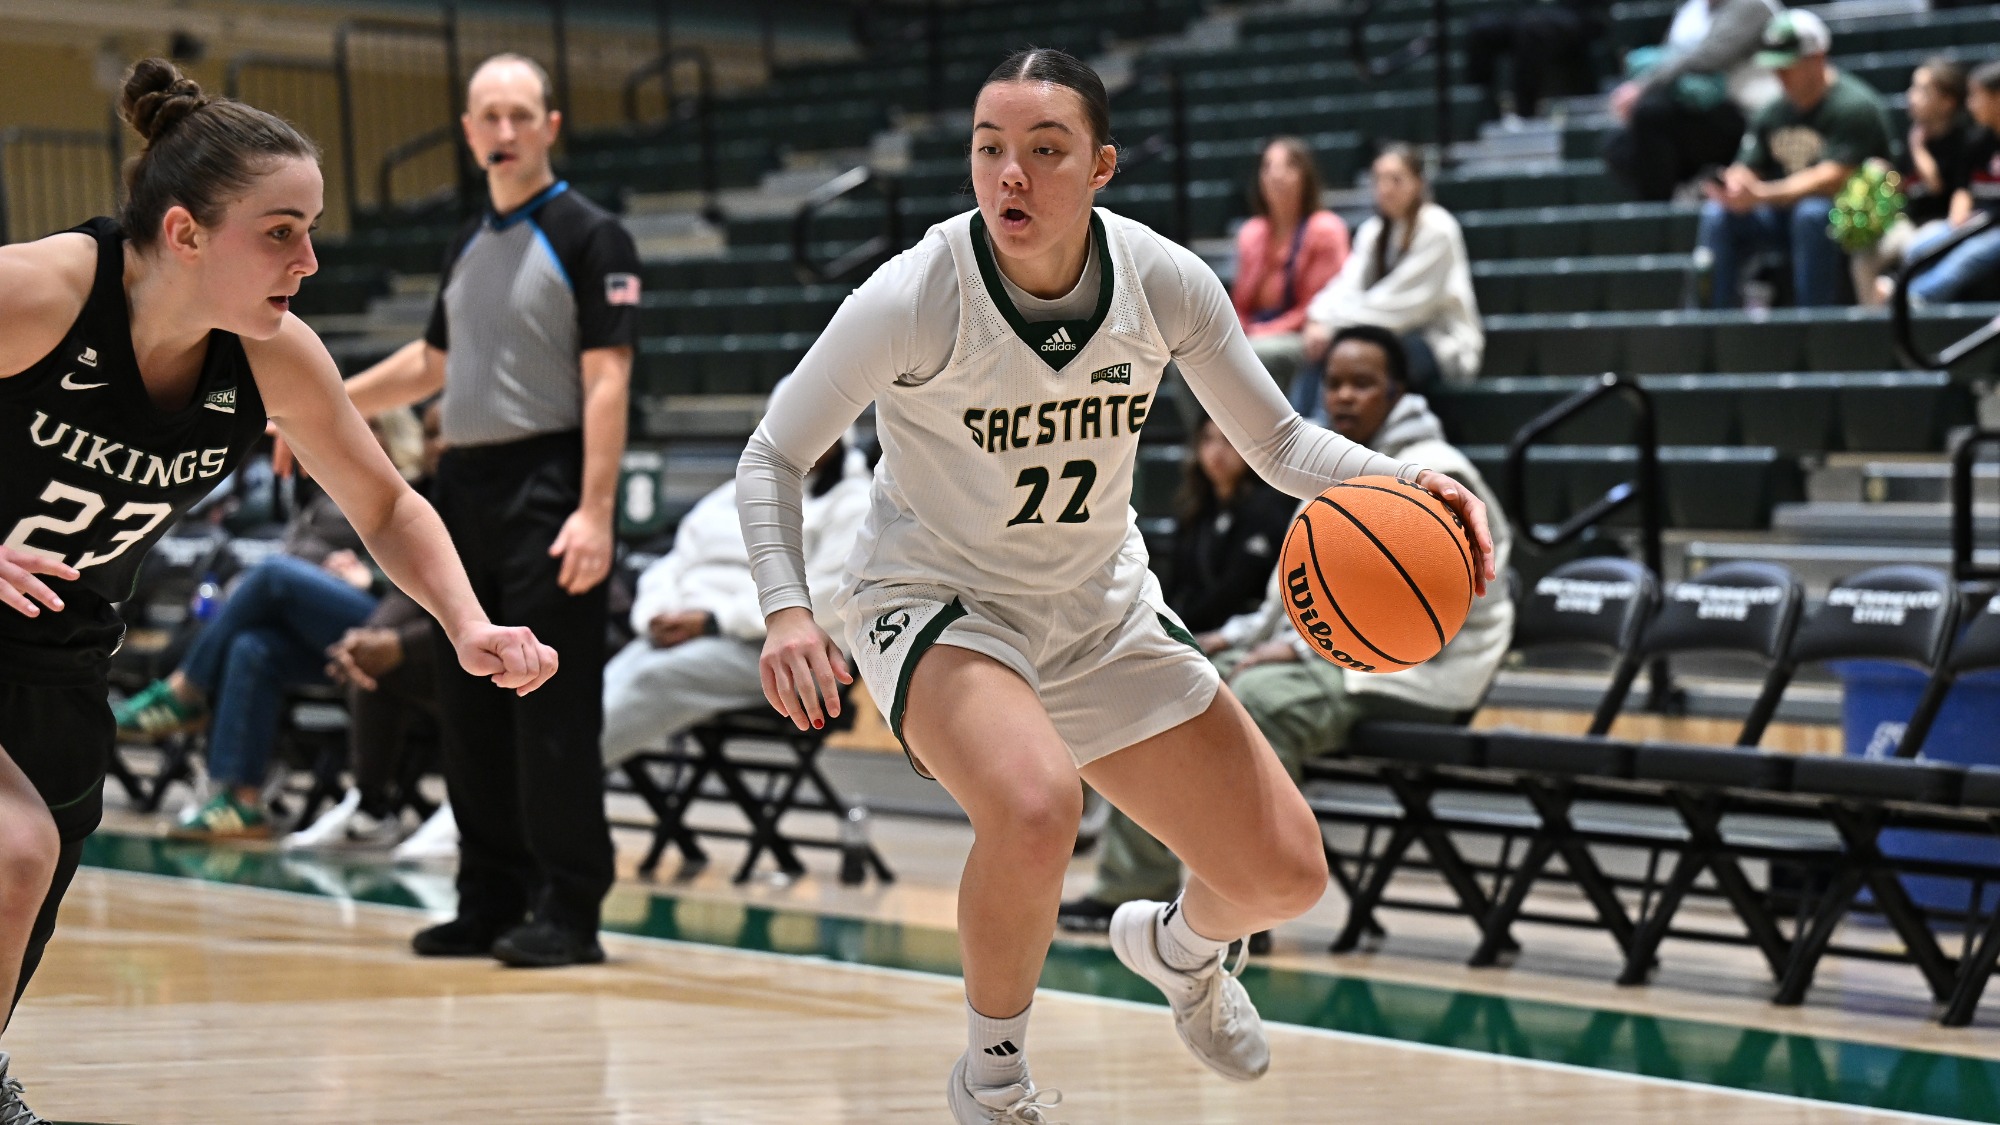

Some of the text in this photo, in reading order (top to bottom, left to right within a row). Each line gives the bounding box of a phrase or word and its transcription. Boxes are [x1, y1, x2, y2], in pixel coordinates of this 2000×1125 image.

[1040, 341, 1076, 351] adidas
[29, 410, 229, 488] VIKINGS
[963, 391, 1151, 454] SAC STATE
[2, 480, 173, 571] 23
[1006, 459, 1097, 528] 22
[1287, 562, 1376, 672] Wilson
